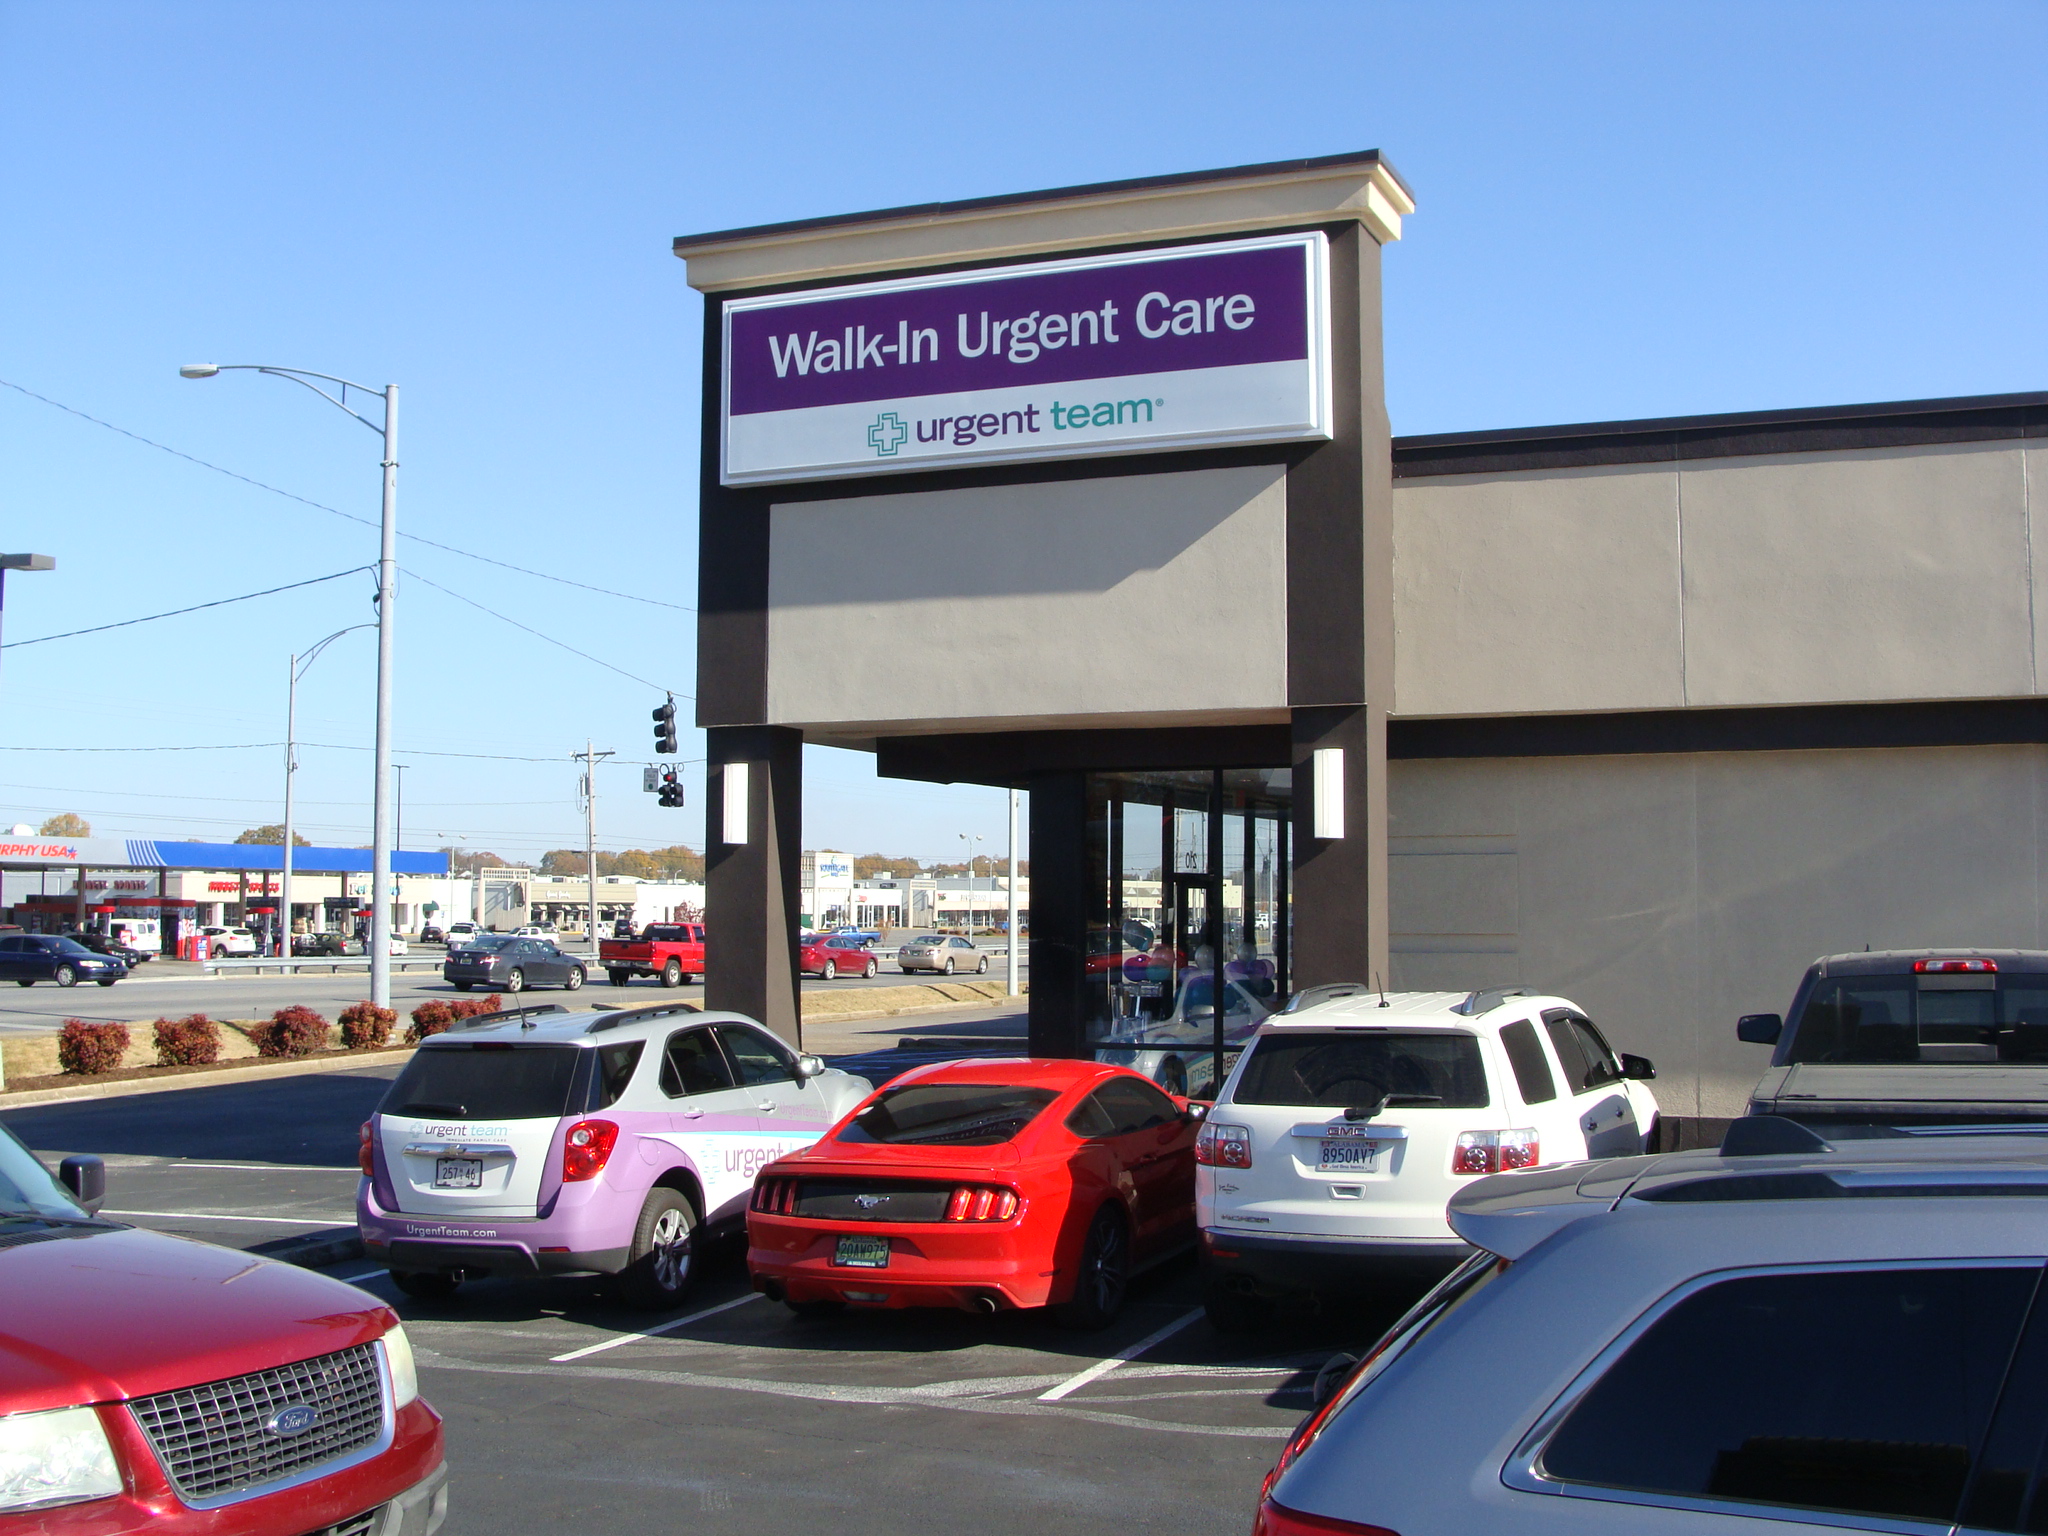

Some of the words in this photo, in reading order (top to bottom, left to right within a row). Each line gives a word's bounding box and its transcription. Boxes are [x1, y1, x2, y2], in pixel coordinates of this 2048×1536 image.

[768, 320, 938, 378] Walk-In
[958, 299, 1119, 364] Urgent
[1135, 291, 1256, 339] Care
[917, 403, 1040, 446] urgent
[0, 843, 40, 857] RPHY
[41, 845, 68, 858] USA
[425, 1125, 467, 1137] urgent
[470, 1125, 508, 1136] team
[1327, 1126, 1368, 1137] GMC
[406, 1224, 497, 1238] UrgentTeam.com
[284, 1411, 310, 1429] Ford
